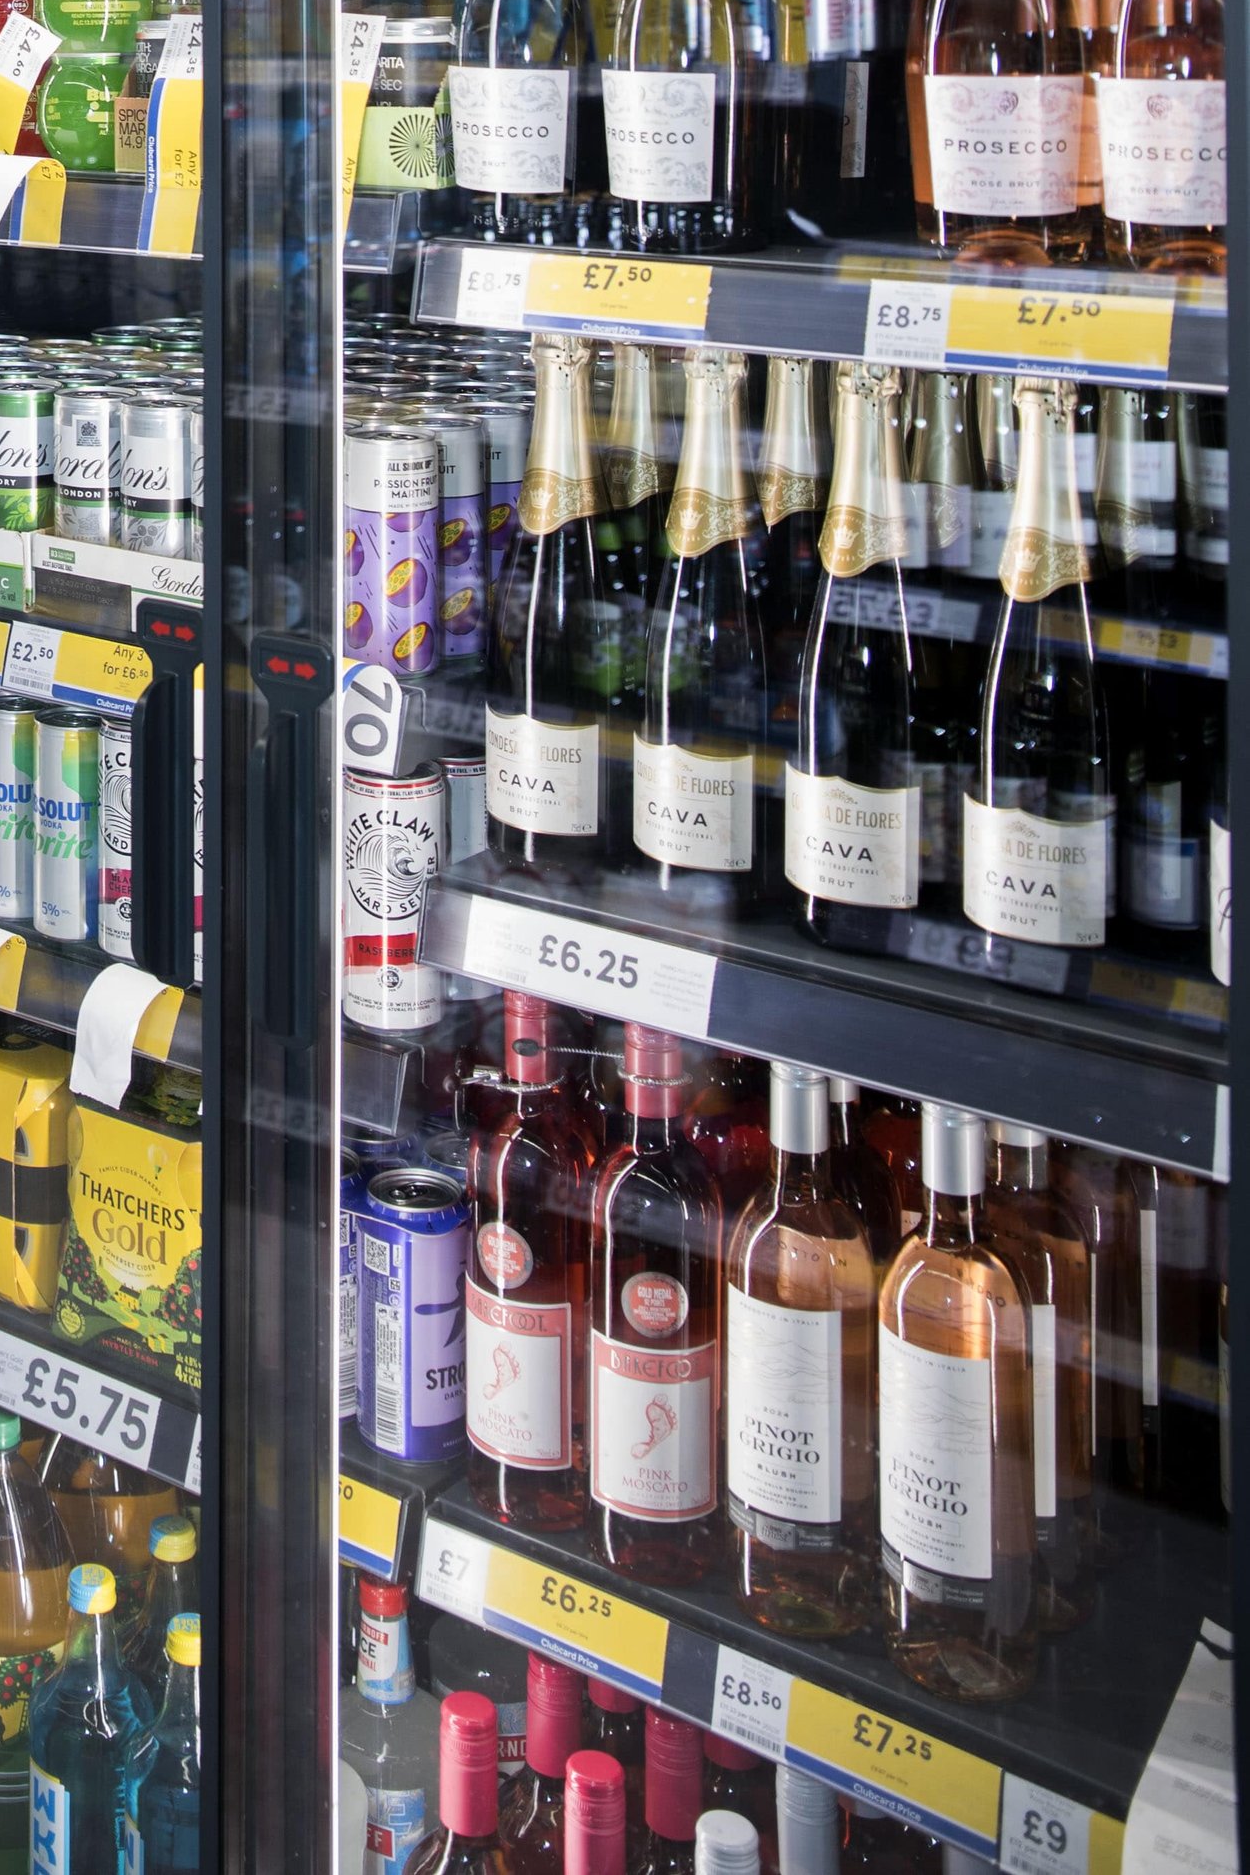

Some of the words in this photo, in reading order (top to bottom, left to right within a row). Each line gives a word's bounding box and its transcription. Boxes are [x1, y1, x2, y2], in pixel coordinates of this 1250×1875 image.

[12, 25, 42, 78] £4.60
[185, 21, 203, 75] £4.35
[454, 120, 550, 139] PROSECCO
[605, 126, 695, 145] PROSECCO
[146, 136, 156, 171] Clubcard
[173, 148, 184, 169] for
[943, 137, 1069, 156] PROSECCO
[187, 150, 198, 175] Any
[175, 170, 185, 188] £7
[191, 176, 199, 188] 2
[1007, 178, 1042, 189] BRUT
[582, 263, 653, 292] £7.50
[877, 303, 942, 329] £8.75
[1017, 296, 1101, 327] £7.50
[581, 321, 615, 334] Clubcard
[616, 323, 641, 337] Price
[373, 477, 418, 492] PASSION
[391, 487, 431, 501] MARTINI
[11, 641, 54, 663] £2.50
[113, 644, 135, 661] Any
[136, 649, 145, 661] 3
[103, 661, 121, 677] for
[122, 664, 149, 680] £6.50
[96, 697, 125, 713] Clubcard
[539, 746, 582, 765] FLORES
[499, 769, 556, 794] CAVA
[691, 776, 735, 797] FLORES
[509, 805, 540, 819] BRUT
[647, 801, 708, 828] CAVA
[835, 807, 851, 824] DE
[855, 809, 904, 831] FLORES
[345, 812, 373, 871] WHITE
[376, 808, 435, 843] CLAW
[658, 838, 692, 854] BRUT
[805, 834, 874, 863] CAVA
[1017, 841, 1035, 859] DE
[1037, 843, 1088, 866] FLORES
[818, 874, 856, 889] BRUT
[985, 869, 1058, 899] CAVA
[41, 901, 60, 917] 5%
[355, 886, 393, 915] HARD
[999, 911, 1038, 928] BRUT
[537, 933, 640, 990] £6.25
[79, 1171, 186, 1232] THATCHERS
[91, 1207, 168, 1266] Gold
[20, 1356, 151, 1452] £5.75
[477, 1414, 533, 1442] MOSCATO
[487, 1409, 517, 1428] PINK
[744, 1415, 815, 1446] PINOT
[738, 1430, 821, 1465] GRIGIO
[638, 1467, 673, 1481] PINK
[756, 1462, 798, 1480] BLUSH
[891, 1457, 962, 1496] PINOT
[621, 1477, 689, 1494] MOSCATO
[887, 1473, 969, 1518] GRIGIO
[903, 1508, 944, 1530] BLUSH
[539, 1575, 613, 1619] £6.25
[540, 1637, 571, 1662] Clubcard
[571, 1651, 600, 1672] Price
[721, 1674, 782, 1711] £8.50
[853, 1712, 934, 1763] £7.25
[852, 1781, 896, 1812] Clubcard
[896, 1799, 923, 1824] Price
[1022, 1808, 1069, 1856] £9
